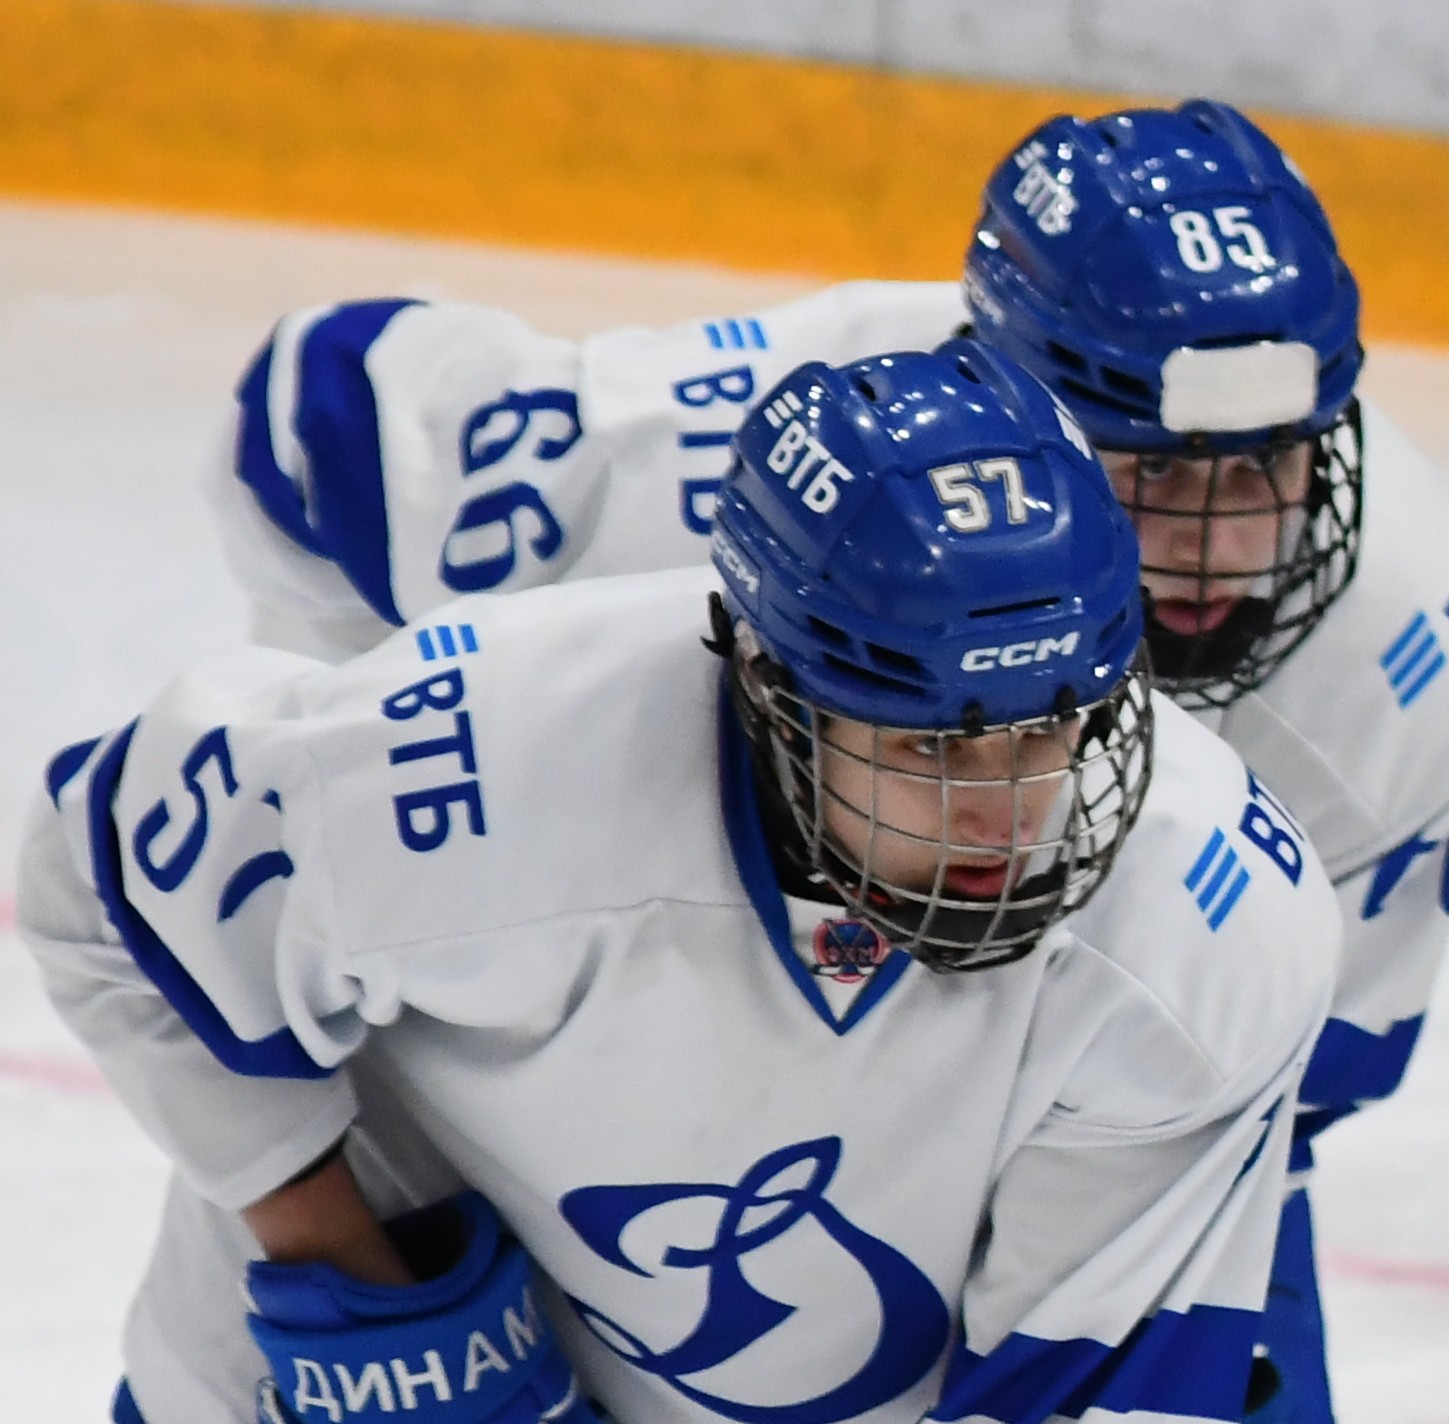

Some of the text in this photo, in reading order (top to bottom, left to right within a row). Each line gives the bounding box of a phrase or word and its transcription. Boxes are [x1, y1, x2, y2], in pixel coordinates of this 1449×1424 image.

[1168, 205, 1276, 274] 85
[766, 421, 854, 516] ВТБ
[929, 456, 1031, 534] 57
[960, 631, 1081, 673] CCM
[380, 667, 488, 853] ВТБ
